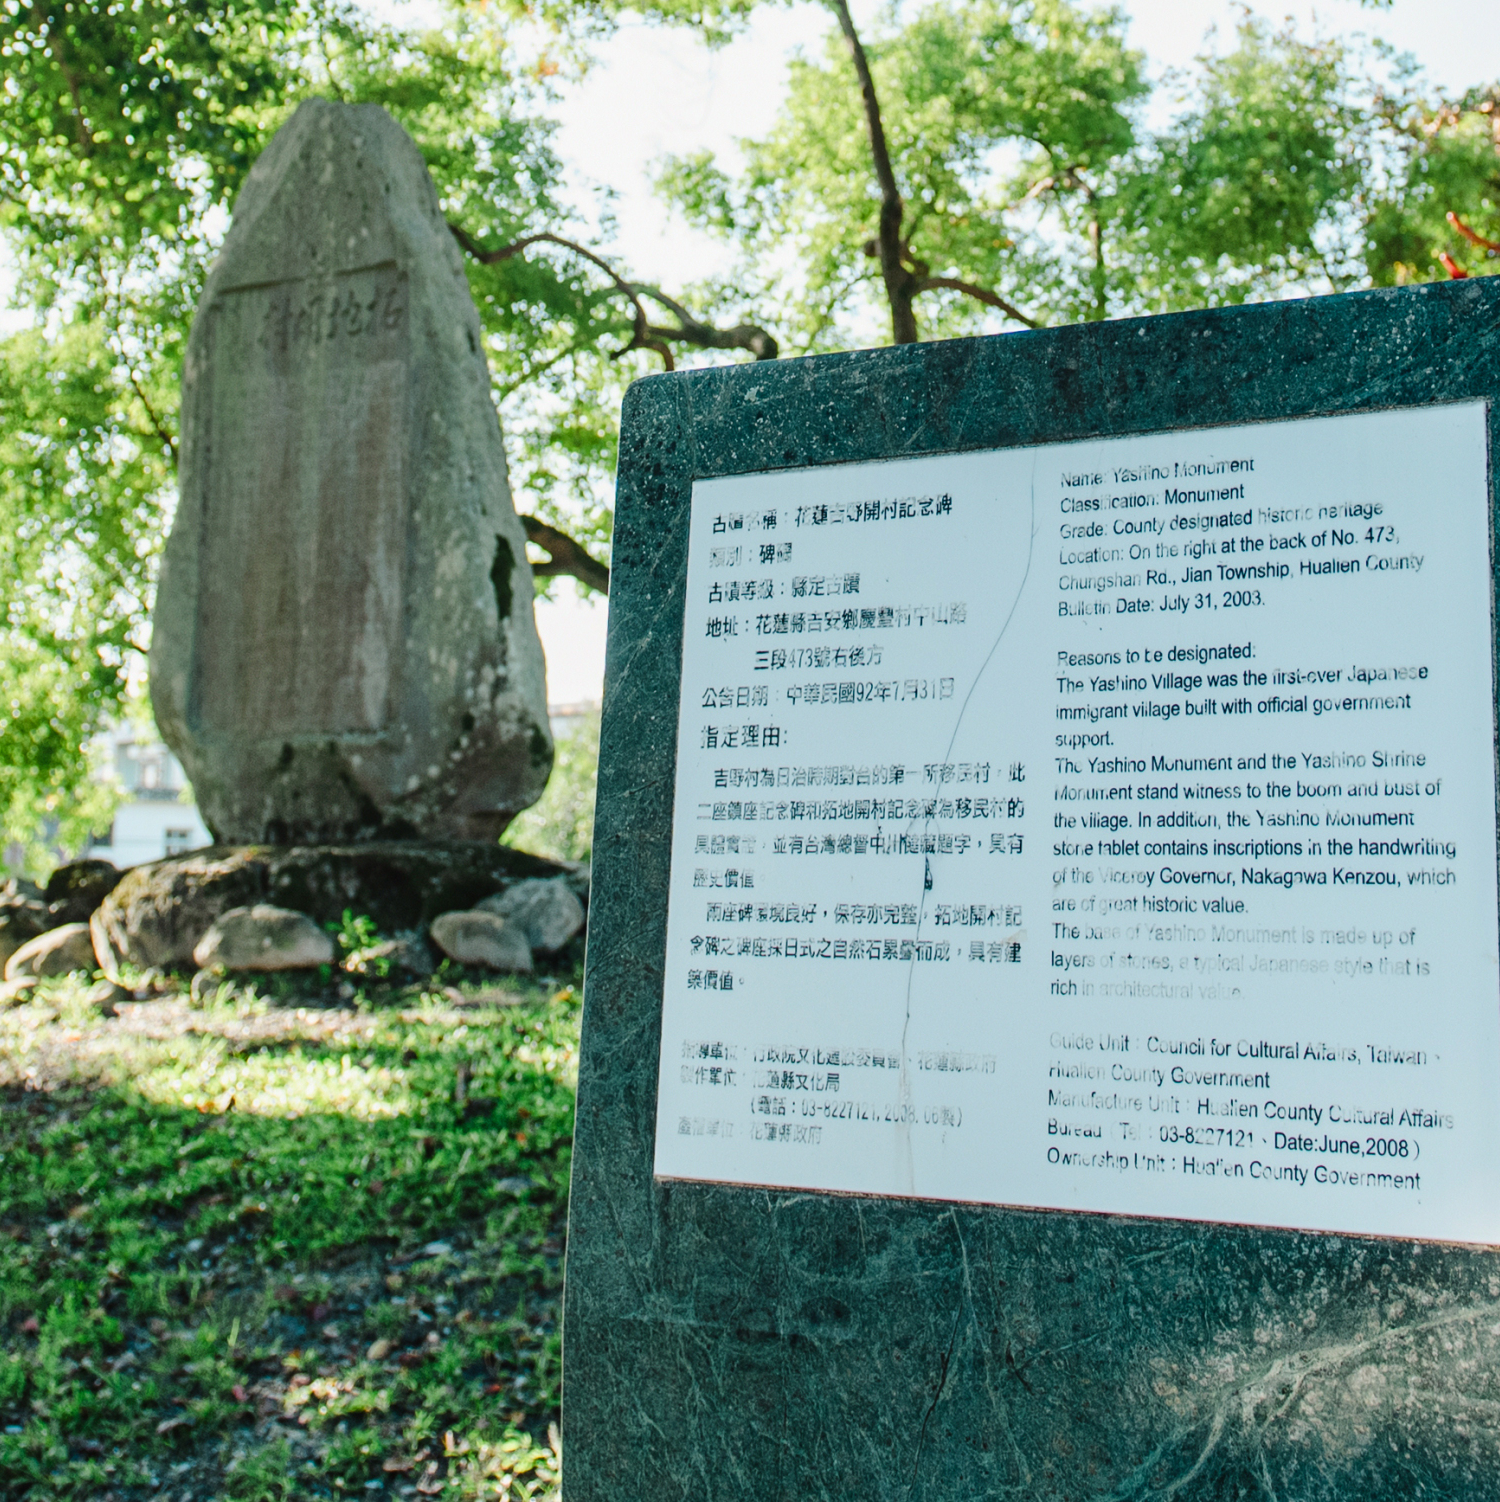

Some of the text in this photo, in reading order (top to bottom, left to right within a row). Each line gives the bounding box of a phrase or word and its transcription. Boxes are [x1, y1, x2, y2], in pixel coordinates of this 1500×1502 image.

[1059, 471, 1107, 489] Name:
[1164, 482, 1245, 505] Monument
[1058, 519, 1108, 540] Grade:
[1112, 516, 1165, 537] County
[1169, 506, 1253, 534] designated
[1058, 523, 1400, 566] Location: On the right at the back of No. 473,
[1057, 569, 1141, 594] Chungshan
[1180, 564, 1212, 584] Jian
[1216, 558, 1296, 582] Township,
[1300, 554, 1361, 576] Hualien
[1365, 551, 1425, 574] County
[1114, 596, 1155, 614] Date:
[1158, 592, 1189, 615] July
[1193, 591, 1217, 612] 31,
[1221, 587, 1265, 608] 2003.
[1056, 649, 1121, 668] Reasons
[1125, 647, 1140, 664] to
[1166, 639, 1256, 666] designated:
[1054, 675, 1084, 694] The
[1087, 672, 1148, 693] Yashino
[1151, 670, 1203, 694] Village
[1207, 672, 1239, 688] was
[1243, 666, 1268, 687] the
[1347, 663, 1430, 687] Japanese
[1054, 690, 1412, 724] immigrant village built with official government
[1054, 729, 1114, 752] support.
[1053, 747, 1427, 775] The Yashino Monument and the Yashino Shrine
[1136, 780, 1179, 800] stand
[1183, 780, 1242, 799] witness
[1246, 781, 1262, 799] to
[1266, 778, 1292, 798] the
[1296, 778, 1343, 798] boom
[1347, 776, 1380, 797] and
[1384, 776, 1421, 796] bust
[1425, 775, 1443, 796] of
[1052, 806, 1415, 833] the village. In addition, the Yashino Monument
[1052, 834, 1457, 861] stone tablet contains inscriptions in the handwriting
[1051, 865, 1066, 884] of
[1069, 865, 1094, 884] the
[1158, 865, 1237, 888] Governor,
[1241, 864, 1328, 890] Nakagawa
[1332, 865, 1402, 888] Kenzou,
[1406, 864, 1457, 885] which
[1051, 897, 1076, 912] are
[1079, 892, 1095, 912] of
[1141, 893, 1197, 913] historic
[1201, 893, 1249, 913] value.
[1050, 920, 1080, 940] The
[1212, 923, 1298, 943] Monument
[1373, 929, 1395, 950] up
[1050, 947, 1095, 973] layers
[1415, 954, 1430, 976] is
[1049, 975, 1077, 996] rich
[1146, 1034, 1206, 1056] Council
[1210, 1036, 1232, 1057] for
[1236, 1038, 1301, 1060] Cultural
[1110, 1062, 1166, 1089] County
[1170, 1064, 1271, 1089] Government
[1261, 1098, 1321, 1127] County
[1397, 1105, 1454, 1129] Affairs
[1248, 1158, 1309, 1188] County
[1313, 1162, 1421, 1190] Government
